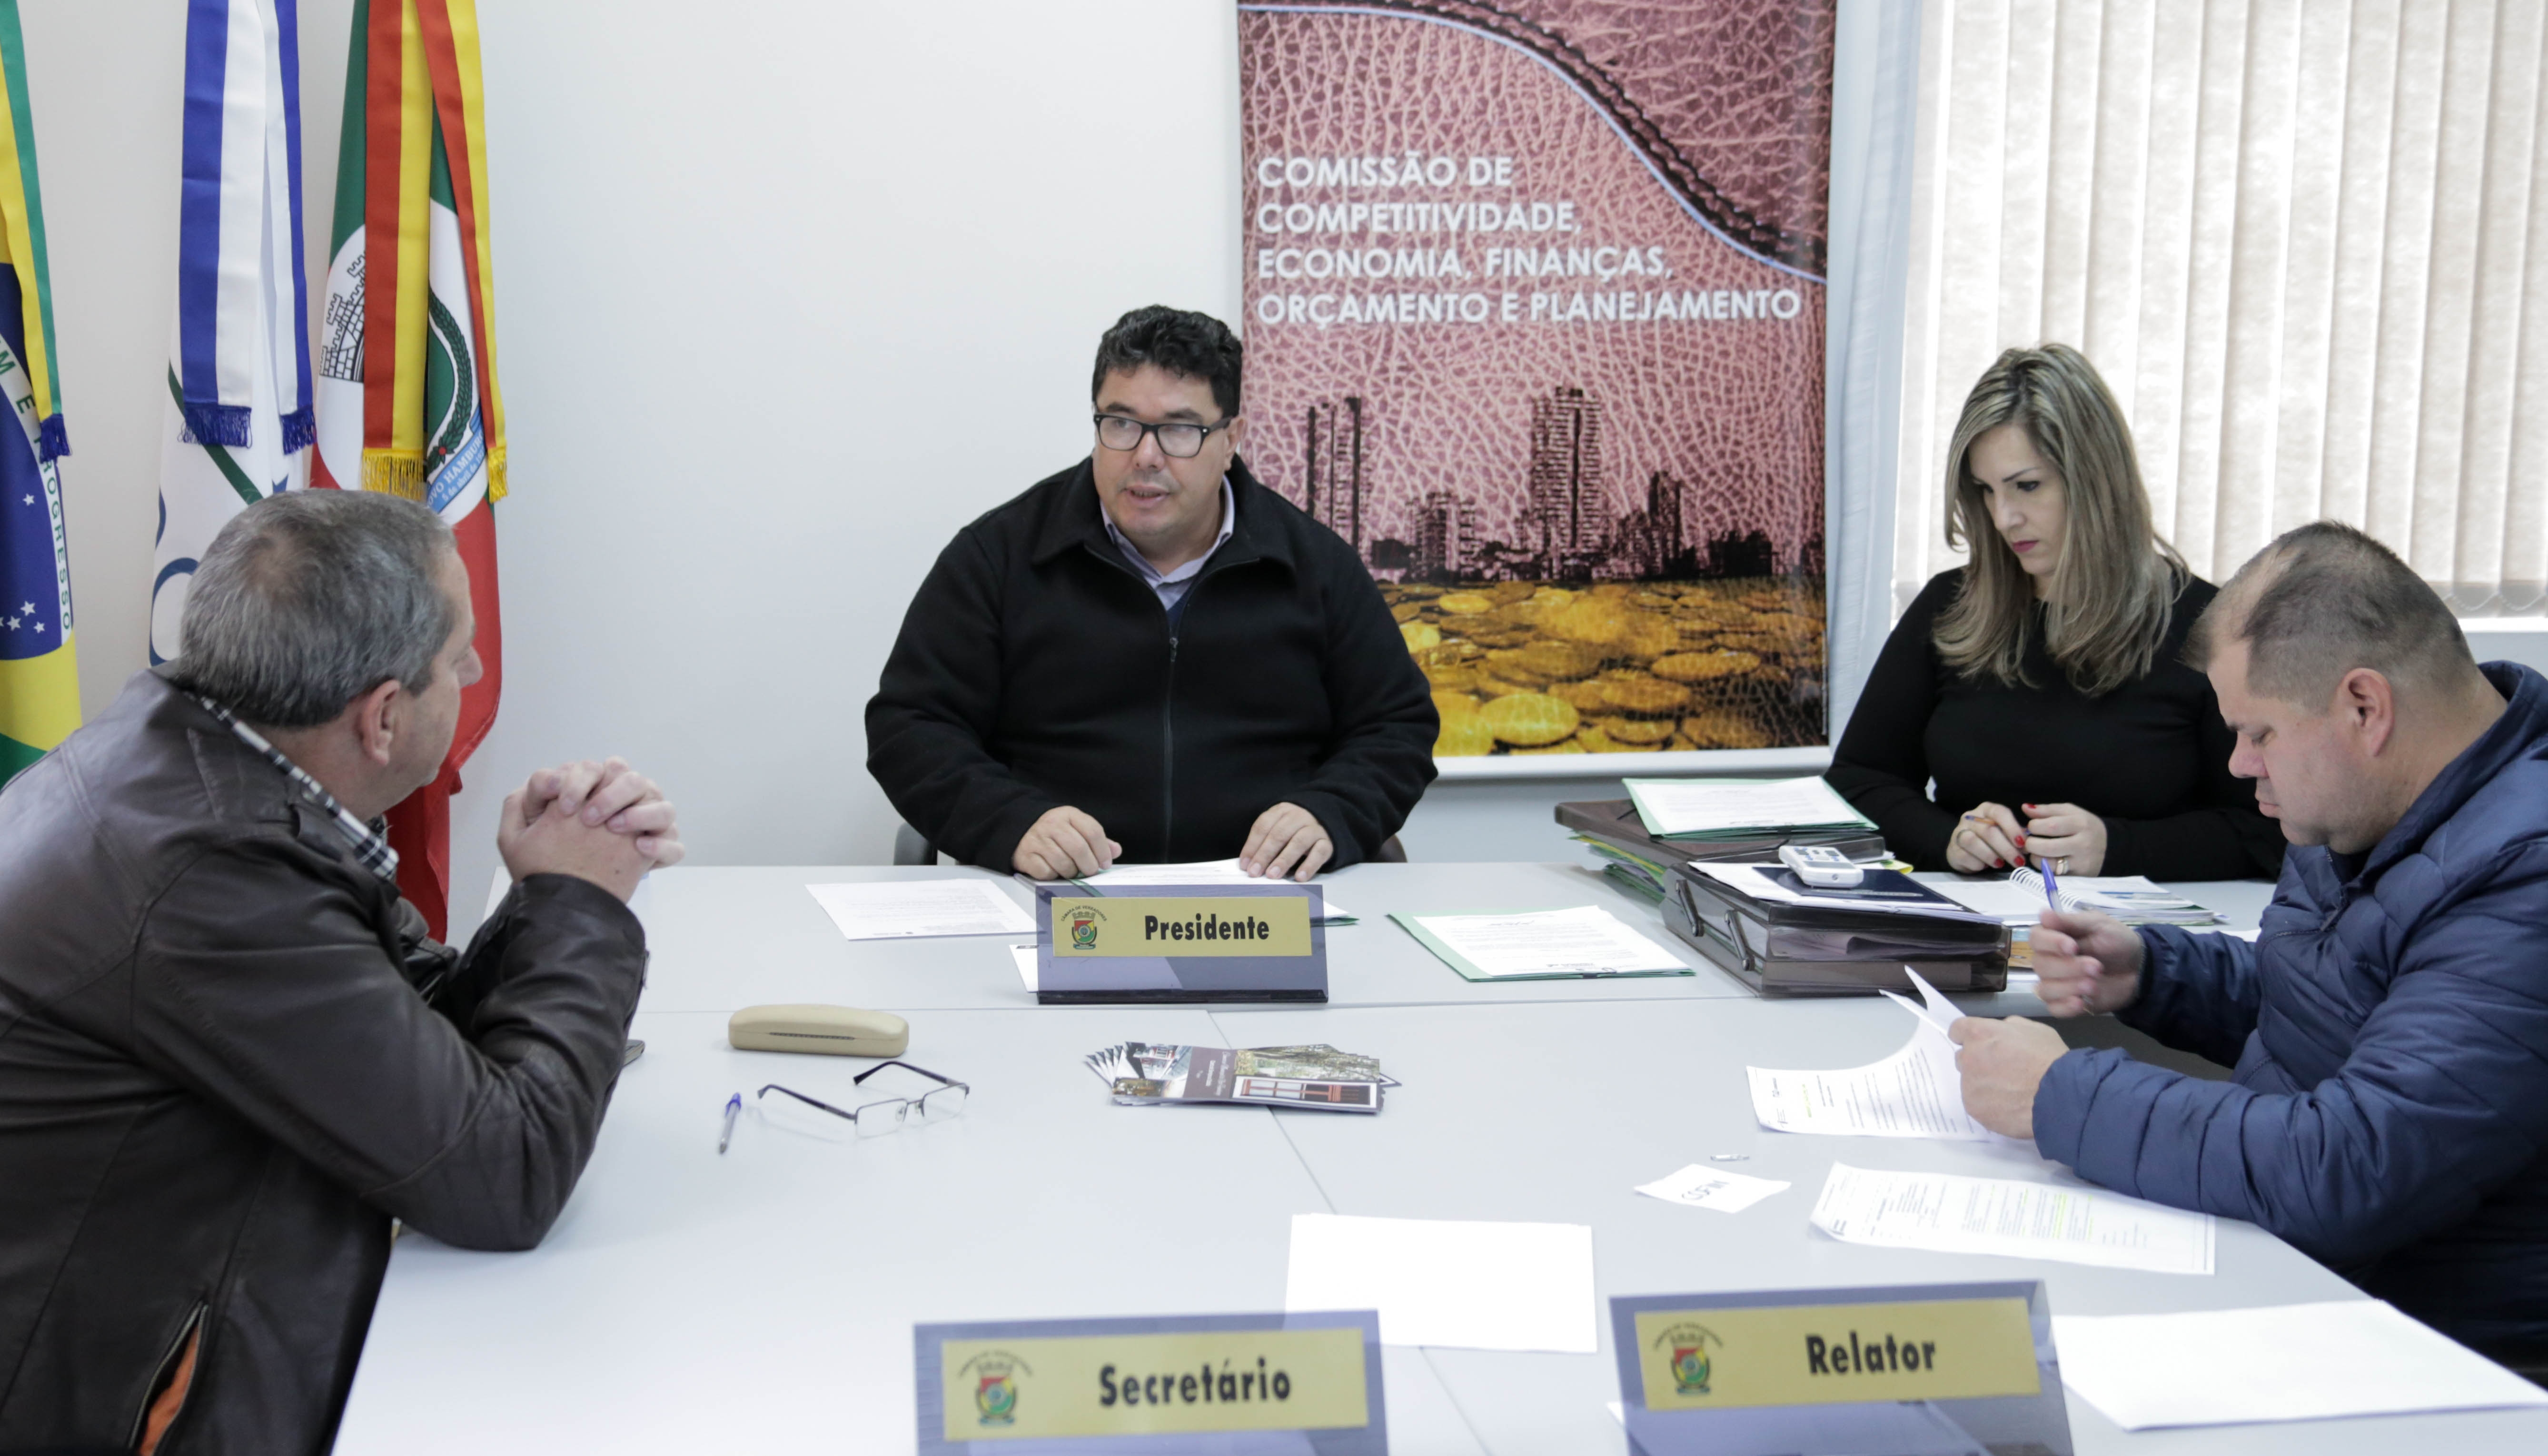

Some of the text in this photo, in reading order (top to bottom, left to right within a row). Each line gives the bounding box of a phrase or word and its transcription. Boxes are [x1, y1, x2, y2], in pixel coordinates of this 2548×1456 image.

[1258, 150, 1512, 188] COMISSÃO DE
[1258, 202, 1582, 234] COMPETITIVIDADE,
[1258, 246, 1673, 283] ECONOMIA, FINANÇAS,
[1258, 288, 1801, 330] ORÇAMENTO E PLANEJAMENTO
[34, 437, 70, 629] ROGRESSO
[1145, 913, 1269, 941] Presidente
[1805, 1330, 1935, 1374] Relator
[1100, 1356, 1290, 1406] Secretário
